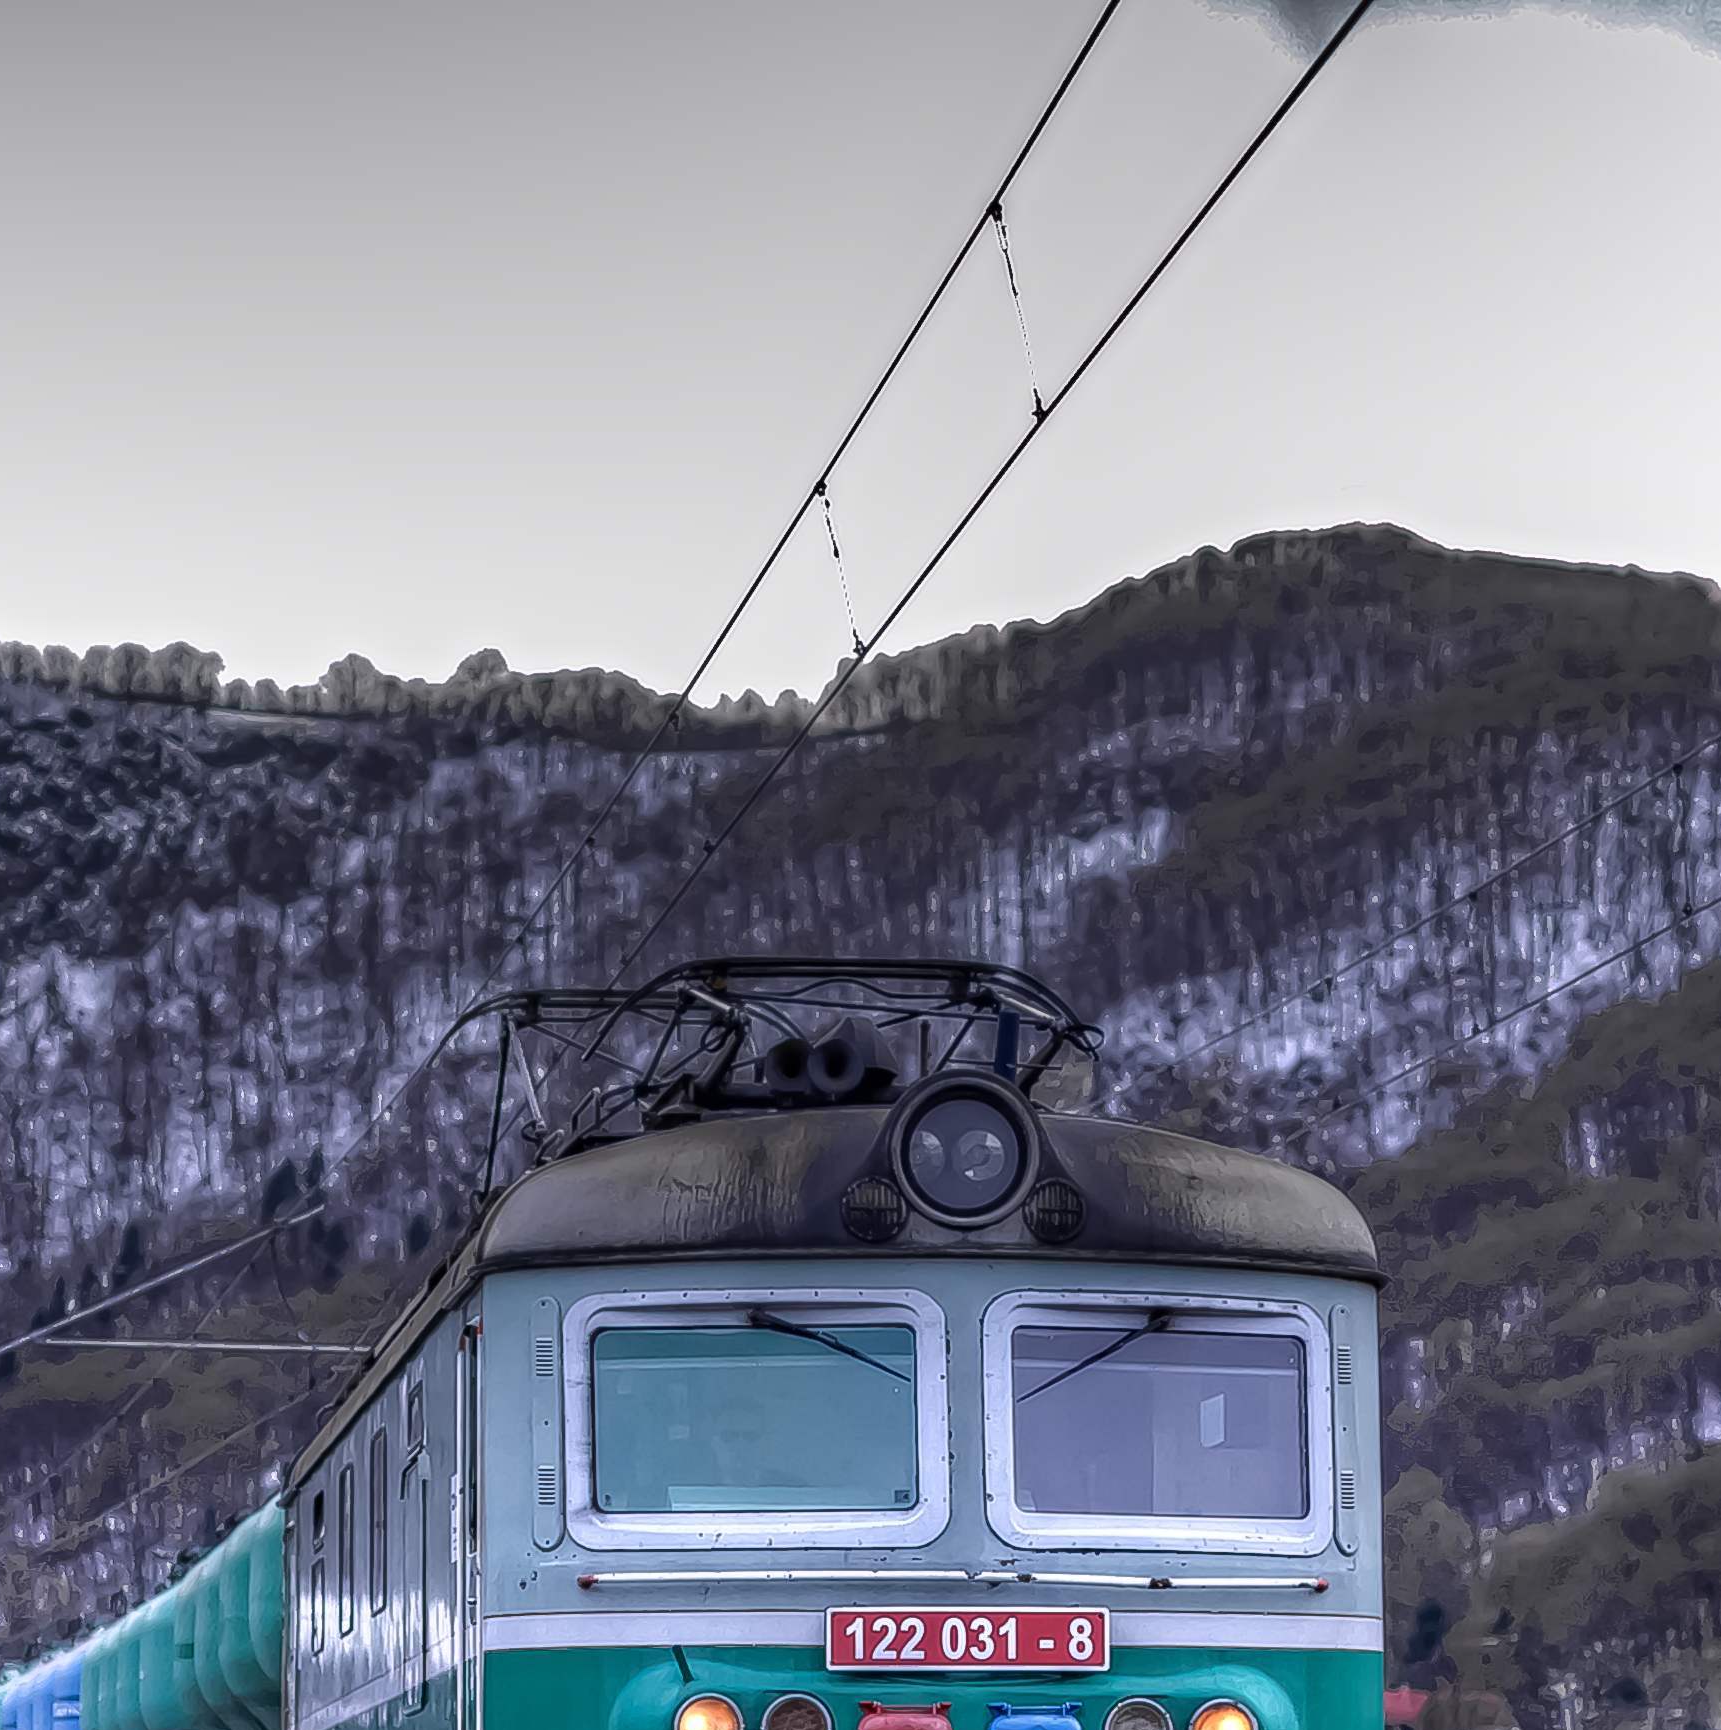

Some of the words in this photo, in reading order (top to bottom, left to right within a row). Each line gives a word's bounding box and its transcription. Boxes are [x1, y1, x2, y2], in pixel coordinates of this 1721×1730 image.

[845, 1617, 925, 1660] 122
[941, 1617, 1018, 1660] 031
[1067, 1617, 1094, 1661] 8
